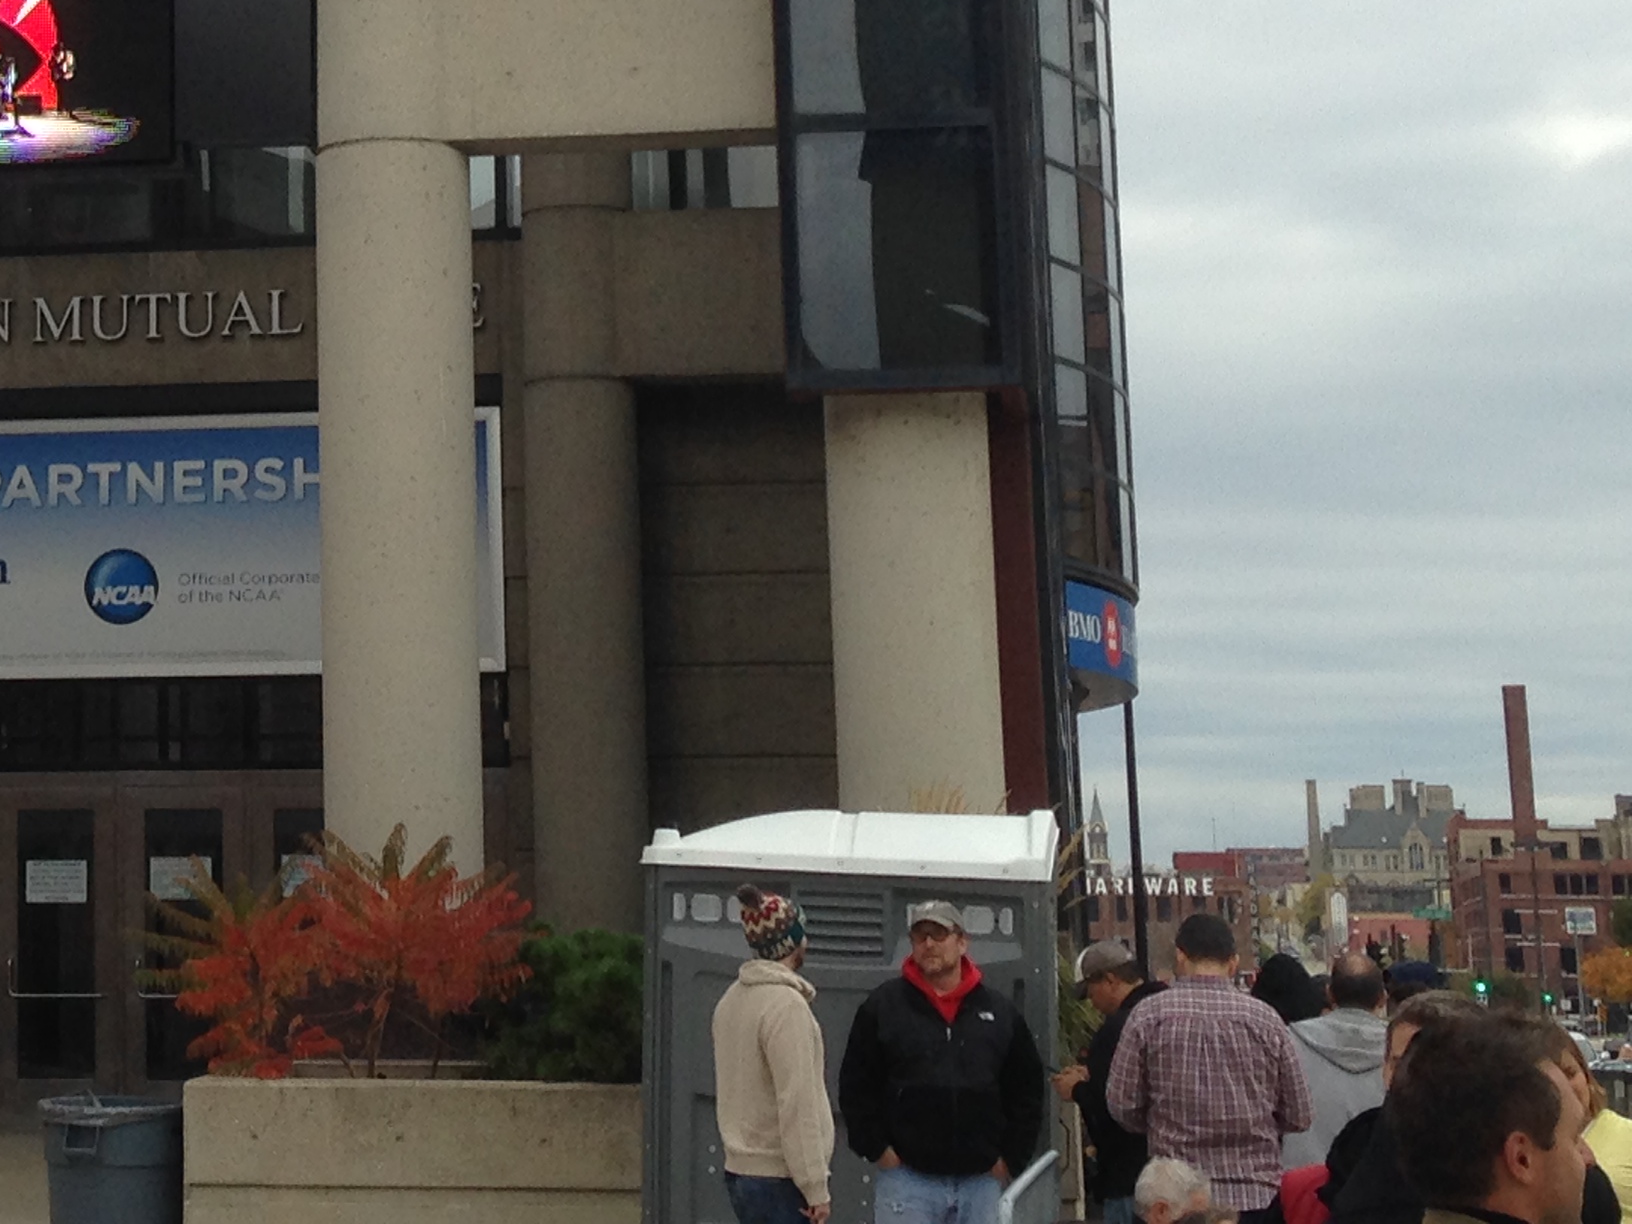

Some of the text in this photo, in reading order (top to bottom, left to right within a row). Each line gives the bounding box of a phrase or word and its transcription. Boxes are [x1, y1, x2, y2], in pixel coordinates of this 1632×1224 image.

[32, 289, 303, 343] MUTUAL
[178, 572, 320, 590] Official Corporate
[92, 584, 158, 607] NCAA
[178, 588, 282, 604] of the NCAA
[1068, 609, 1101, 644] BMO
